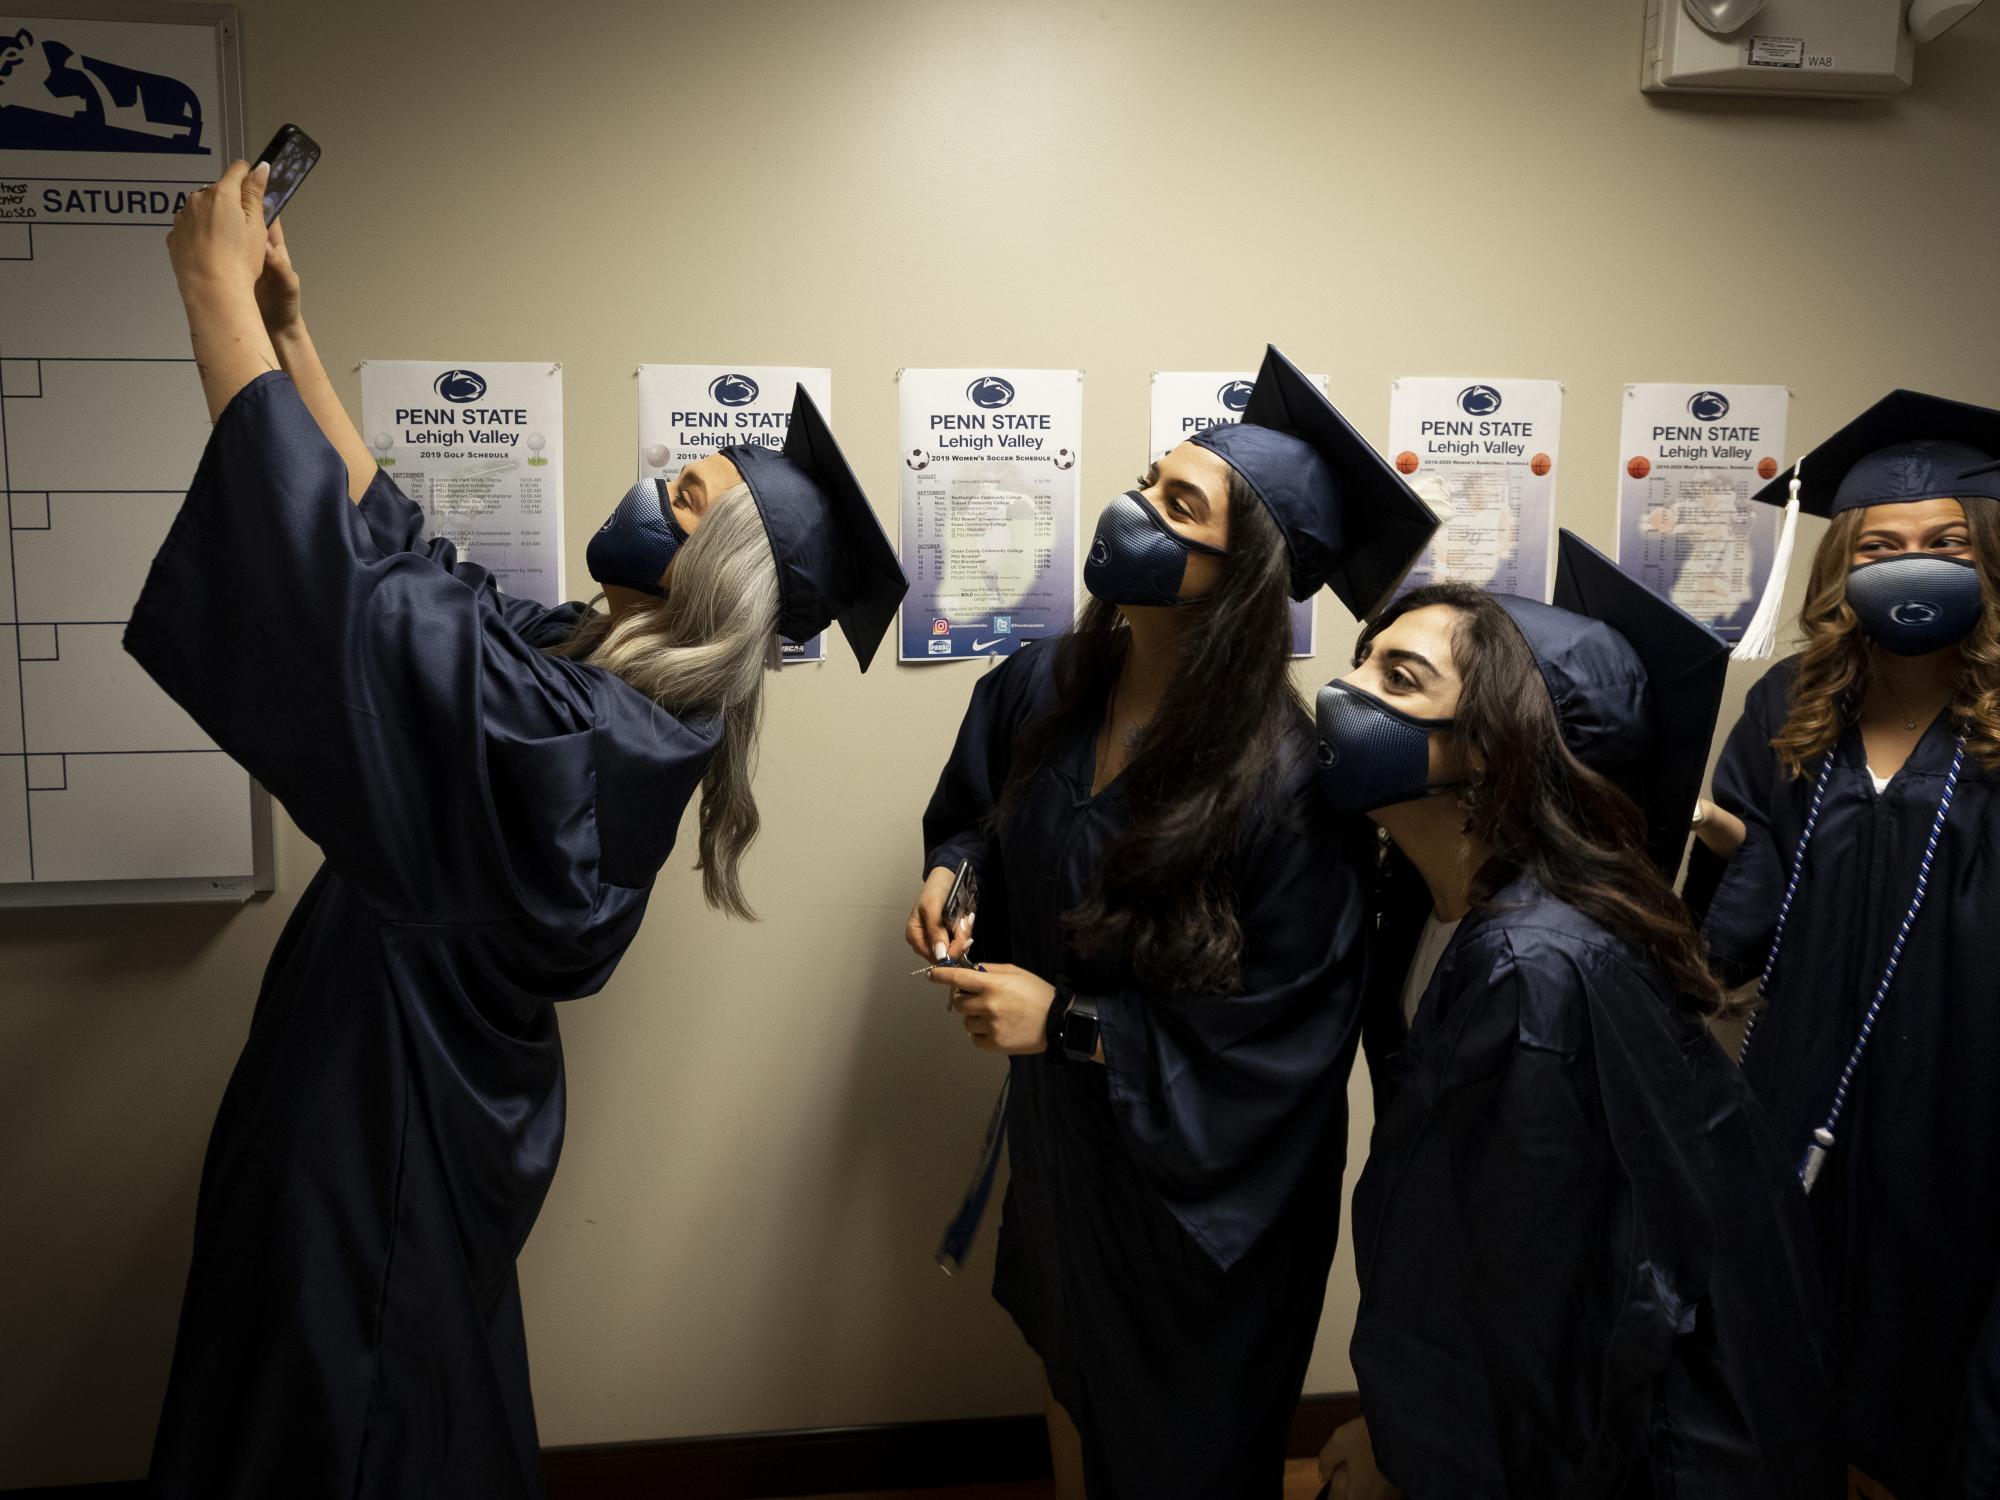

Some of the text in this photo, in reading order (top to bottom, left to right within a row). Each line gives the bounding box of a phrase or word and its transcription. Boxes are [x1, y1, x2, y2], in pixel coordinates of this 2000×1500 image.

[1808, 56, 1833, 67] WA8
[43, 188, 193, 214] SATURDA
[396, 408, 528, 425] PENN STATE
[671, 411, 728, 427] PENN
[930, 414, 1051, 430] PENN STATE
[1421, 421, 1533, 437] PENN STATE
[1653, 426, 1760, 441] PENN STATE
[405, 429, 520, 447] Lehigh Valley
[680, 432, 736, 449] Lehigh
[939, 434, 1043, 451] Lehigh Valley
[420, 451, 442, 459] 2019
[1428, 440, 1525, 456] Lehigh Valley
[1659, 445, 1752, 460] Lehigh Valley
